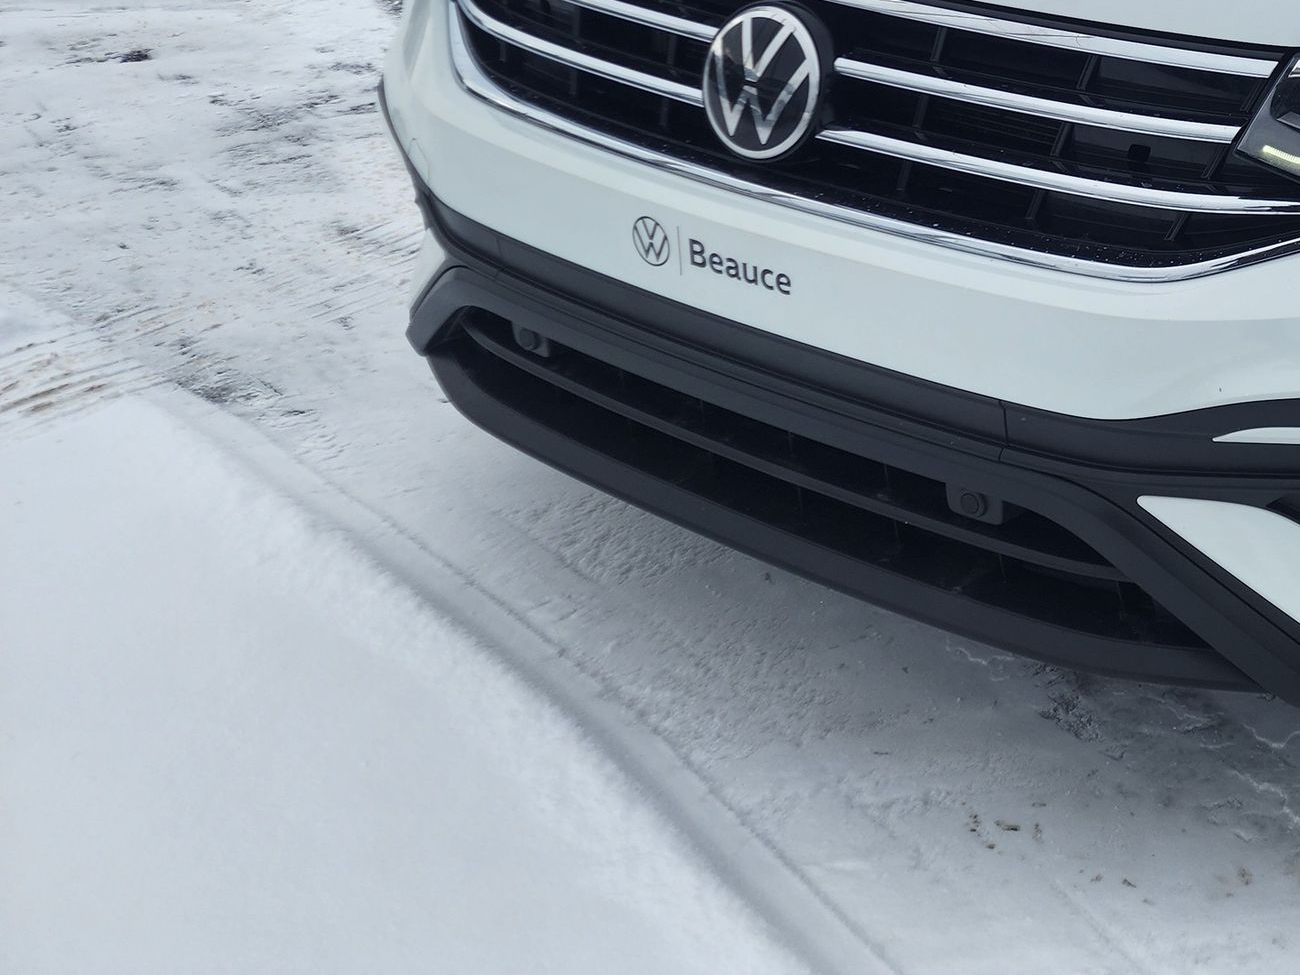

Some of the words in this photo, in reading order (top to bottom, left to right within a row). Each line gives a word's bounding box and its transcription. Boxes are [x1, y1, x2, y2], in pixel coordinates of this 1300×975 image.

[704, 7, 820, 158] VW
[632, 215, 671, 267] VW
[688, 238, 792, 295] Beauce
